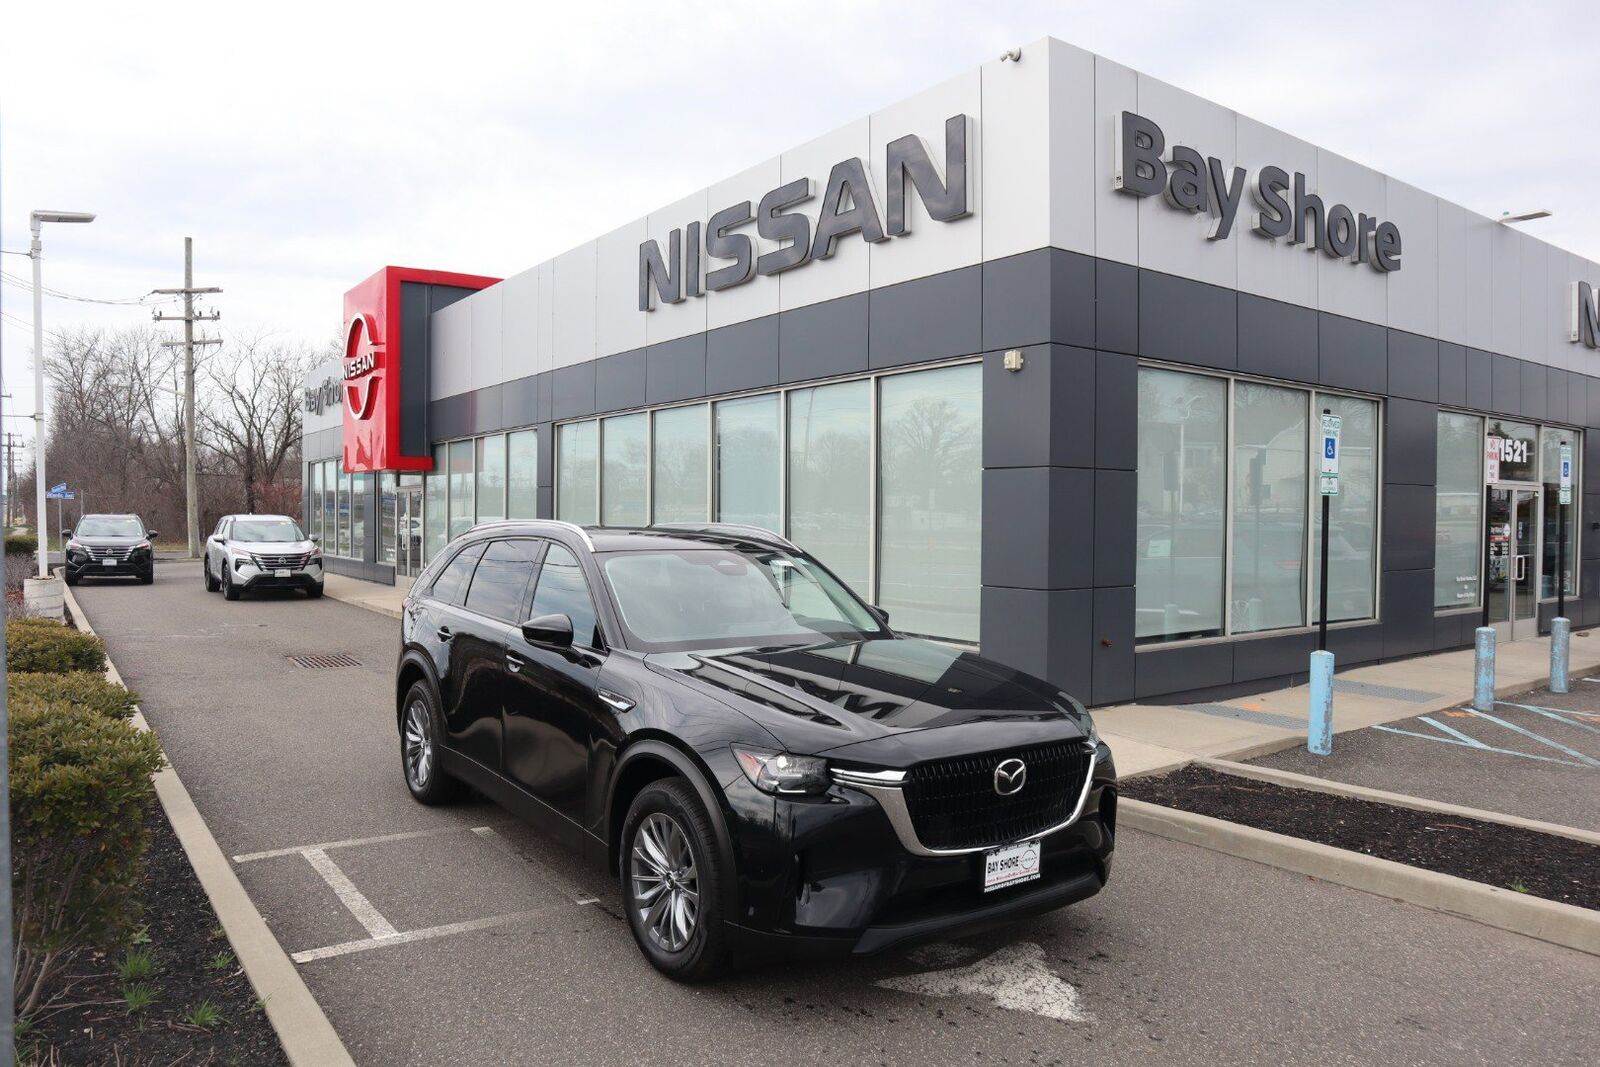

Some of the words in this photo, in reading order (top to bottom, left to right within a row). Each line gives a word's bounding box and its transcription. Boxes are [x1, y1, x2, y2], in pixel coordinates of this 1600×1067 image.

[1115, 110, 1247, 241] Bay
[1252, 165, 1402, 272] Shore
[639, 113, 972, 312] NISSAN
[343, 353, 374, 380] NISSAN
[305, 384, 324, 416] Bay
[1499, 438, 1527, 463] 1521
[988, 860, 1000, 874] BAY
[1000, 855, 1020, 871] SHORE
